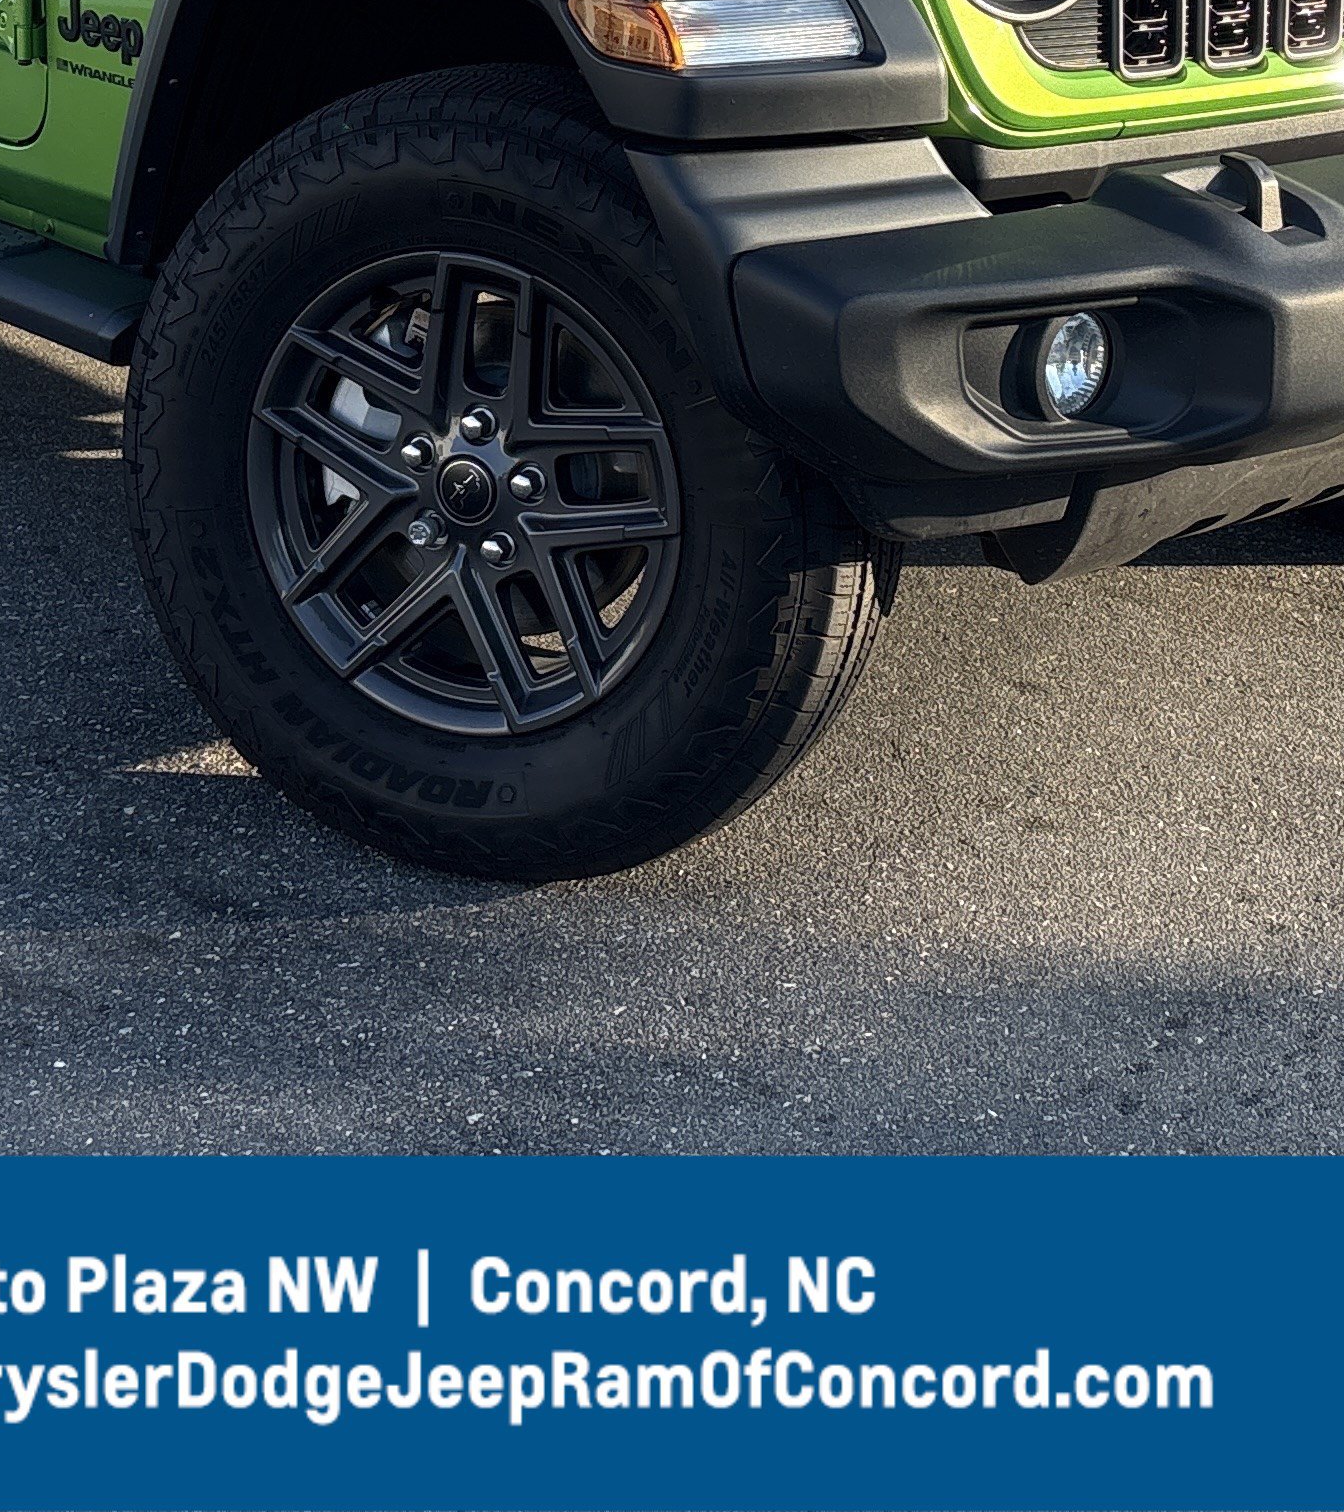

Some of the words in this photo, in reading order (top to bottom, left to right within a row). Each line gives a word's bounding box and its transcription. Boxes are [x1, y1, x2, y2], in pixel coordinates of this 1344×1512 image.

[69, 59, 136, 89] WRANGLE
[470, 190, 694, 375] NEXEN
[683, 548, 737, 699] All-Weather
[269, 691, 495, 810] ROADIAN
